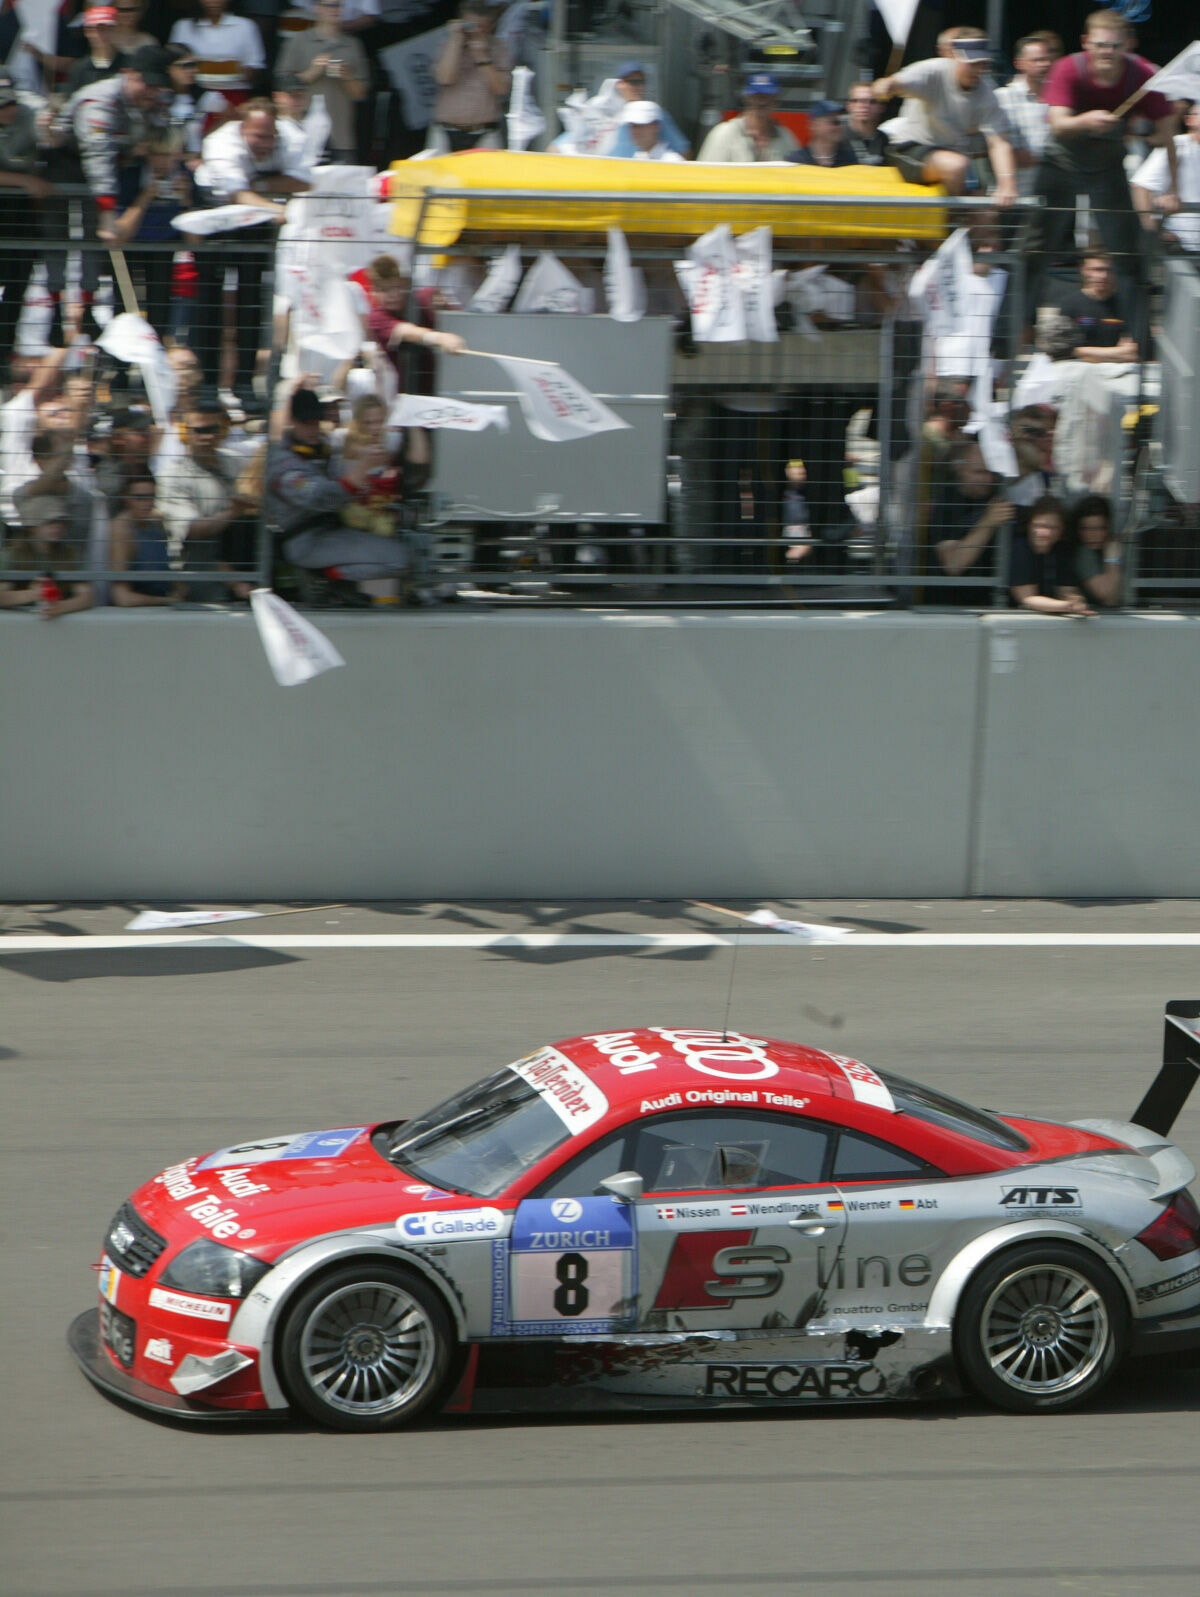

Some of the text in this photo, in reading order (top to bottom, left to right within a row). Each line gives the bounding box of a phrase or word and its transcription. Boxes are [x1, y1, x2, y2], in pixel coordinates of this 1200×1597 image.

[581, 1031, 662, 1075] Audi
[640, 1090, 682, 1113] Audi
[685, 1089, 758, 1104] Original
[215, 1168, 270, 1198] Audi
[917, 1199, 938, 1209] Abt
[998, 1187, 1080, 1205] ATS
[676, 1207, 720, 1219] Nissen
[749, 1202, 820, 1215] Wendlinger
[848, 1200, 891, 1212] Werner
[529, 1229, 611, 1249] ZÜRICH
[704, 1244, 932, 1299] S line
[554, 1252, 589, 1316] 8
[165, 1297, 226, 1315] MICHELIN
[833, 1304, 883, 1315] quattro
[705, 1365, 887, 1397] RECARO
